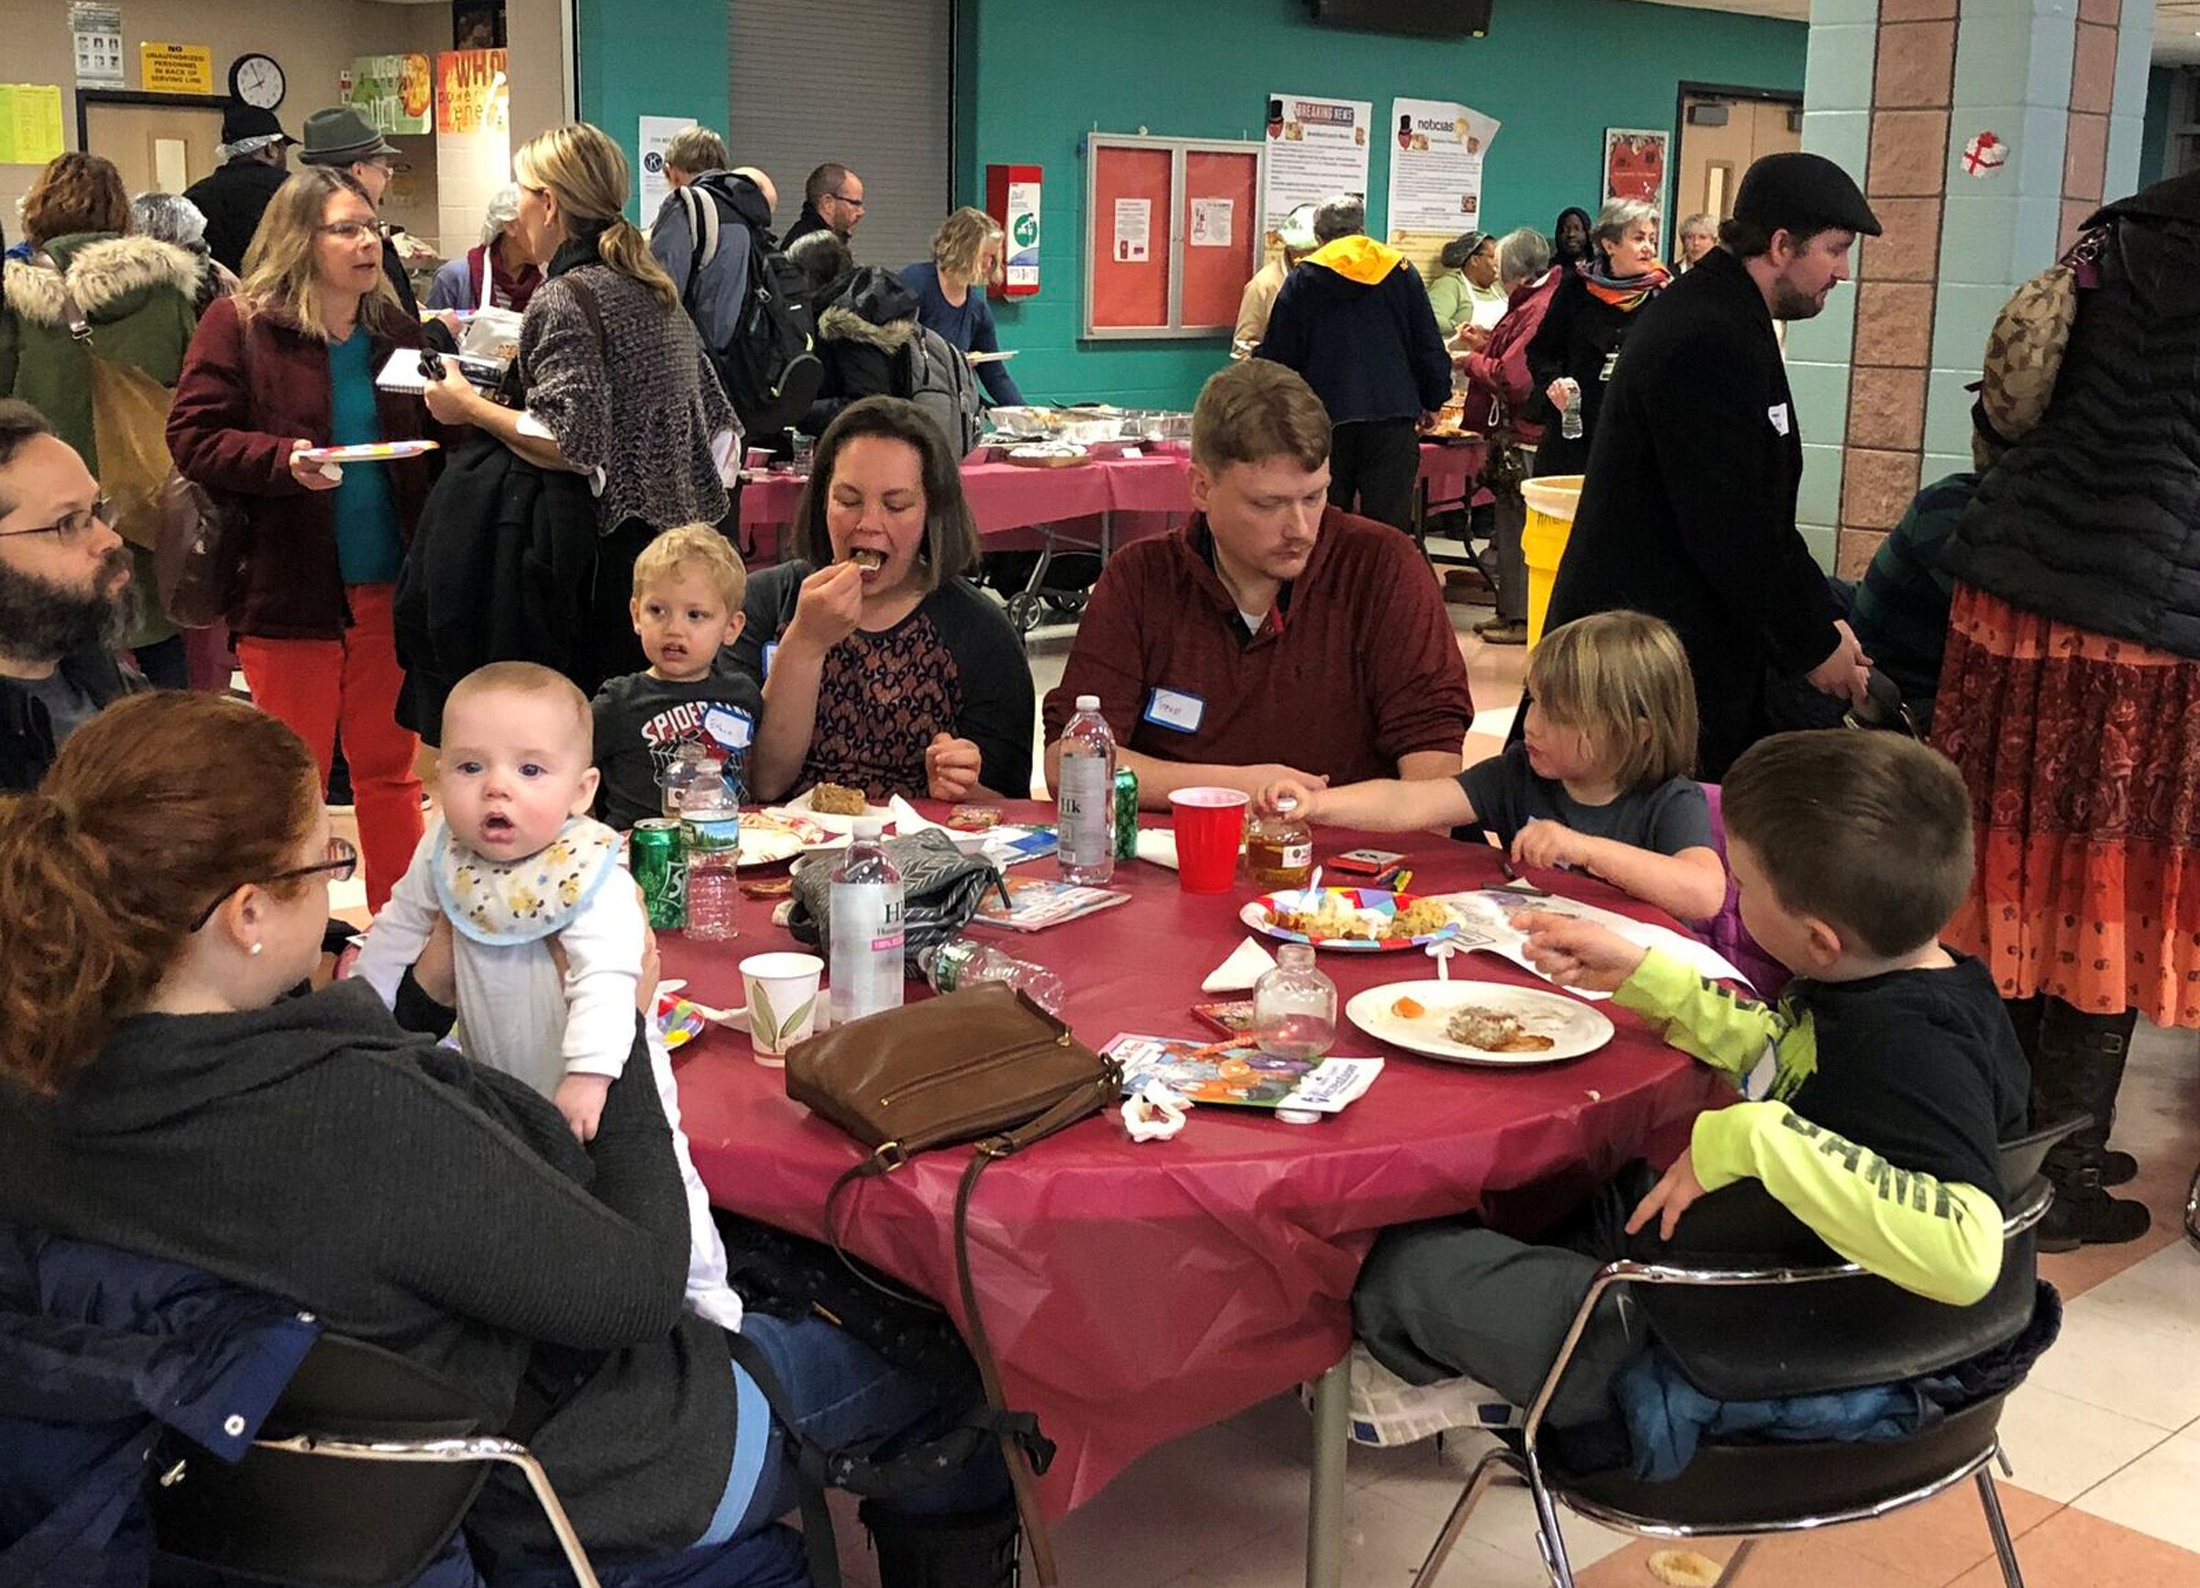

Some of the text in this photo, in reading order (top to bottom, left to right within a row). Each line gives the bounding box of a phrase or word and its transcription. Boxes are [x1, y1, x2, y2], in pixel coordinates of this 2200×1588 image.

[167, 45, 183, 53] NO
[146, 53, 205, 62] UNAUTHORIZED
[154, 61, 197, 69] PERSONNEL
[151, 75, 183, 83] SERVING
[1297, 103, 1354, 121] BREAKING NEWS
